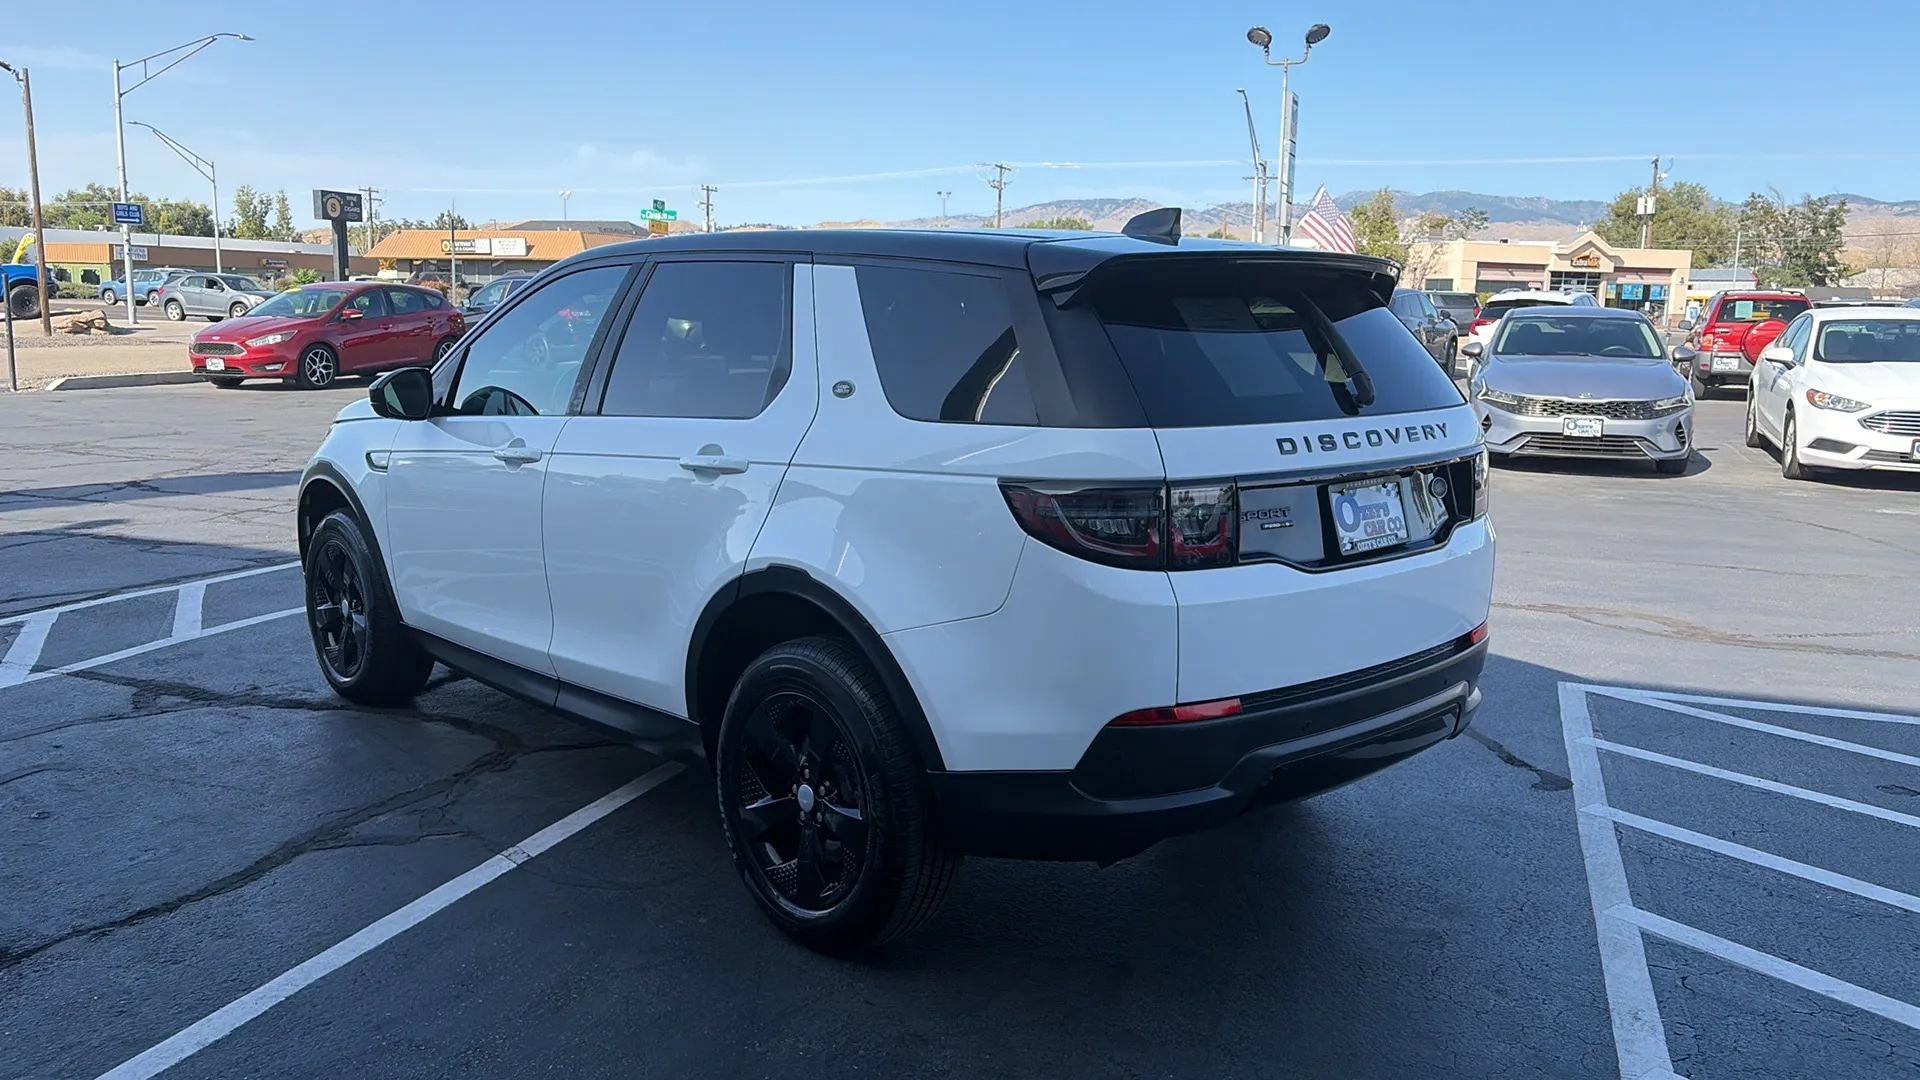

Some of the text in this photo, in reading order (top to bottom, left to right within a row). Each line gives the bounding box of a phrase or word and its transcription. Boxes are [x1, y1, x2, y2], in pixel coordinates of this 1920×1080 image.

[1276, 422, 1448, 456] DISCOVERY
[1240, 507, 1291, 521] SPORT
[1363, 519, 1387, 538] CAR
